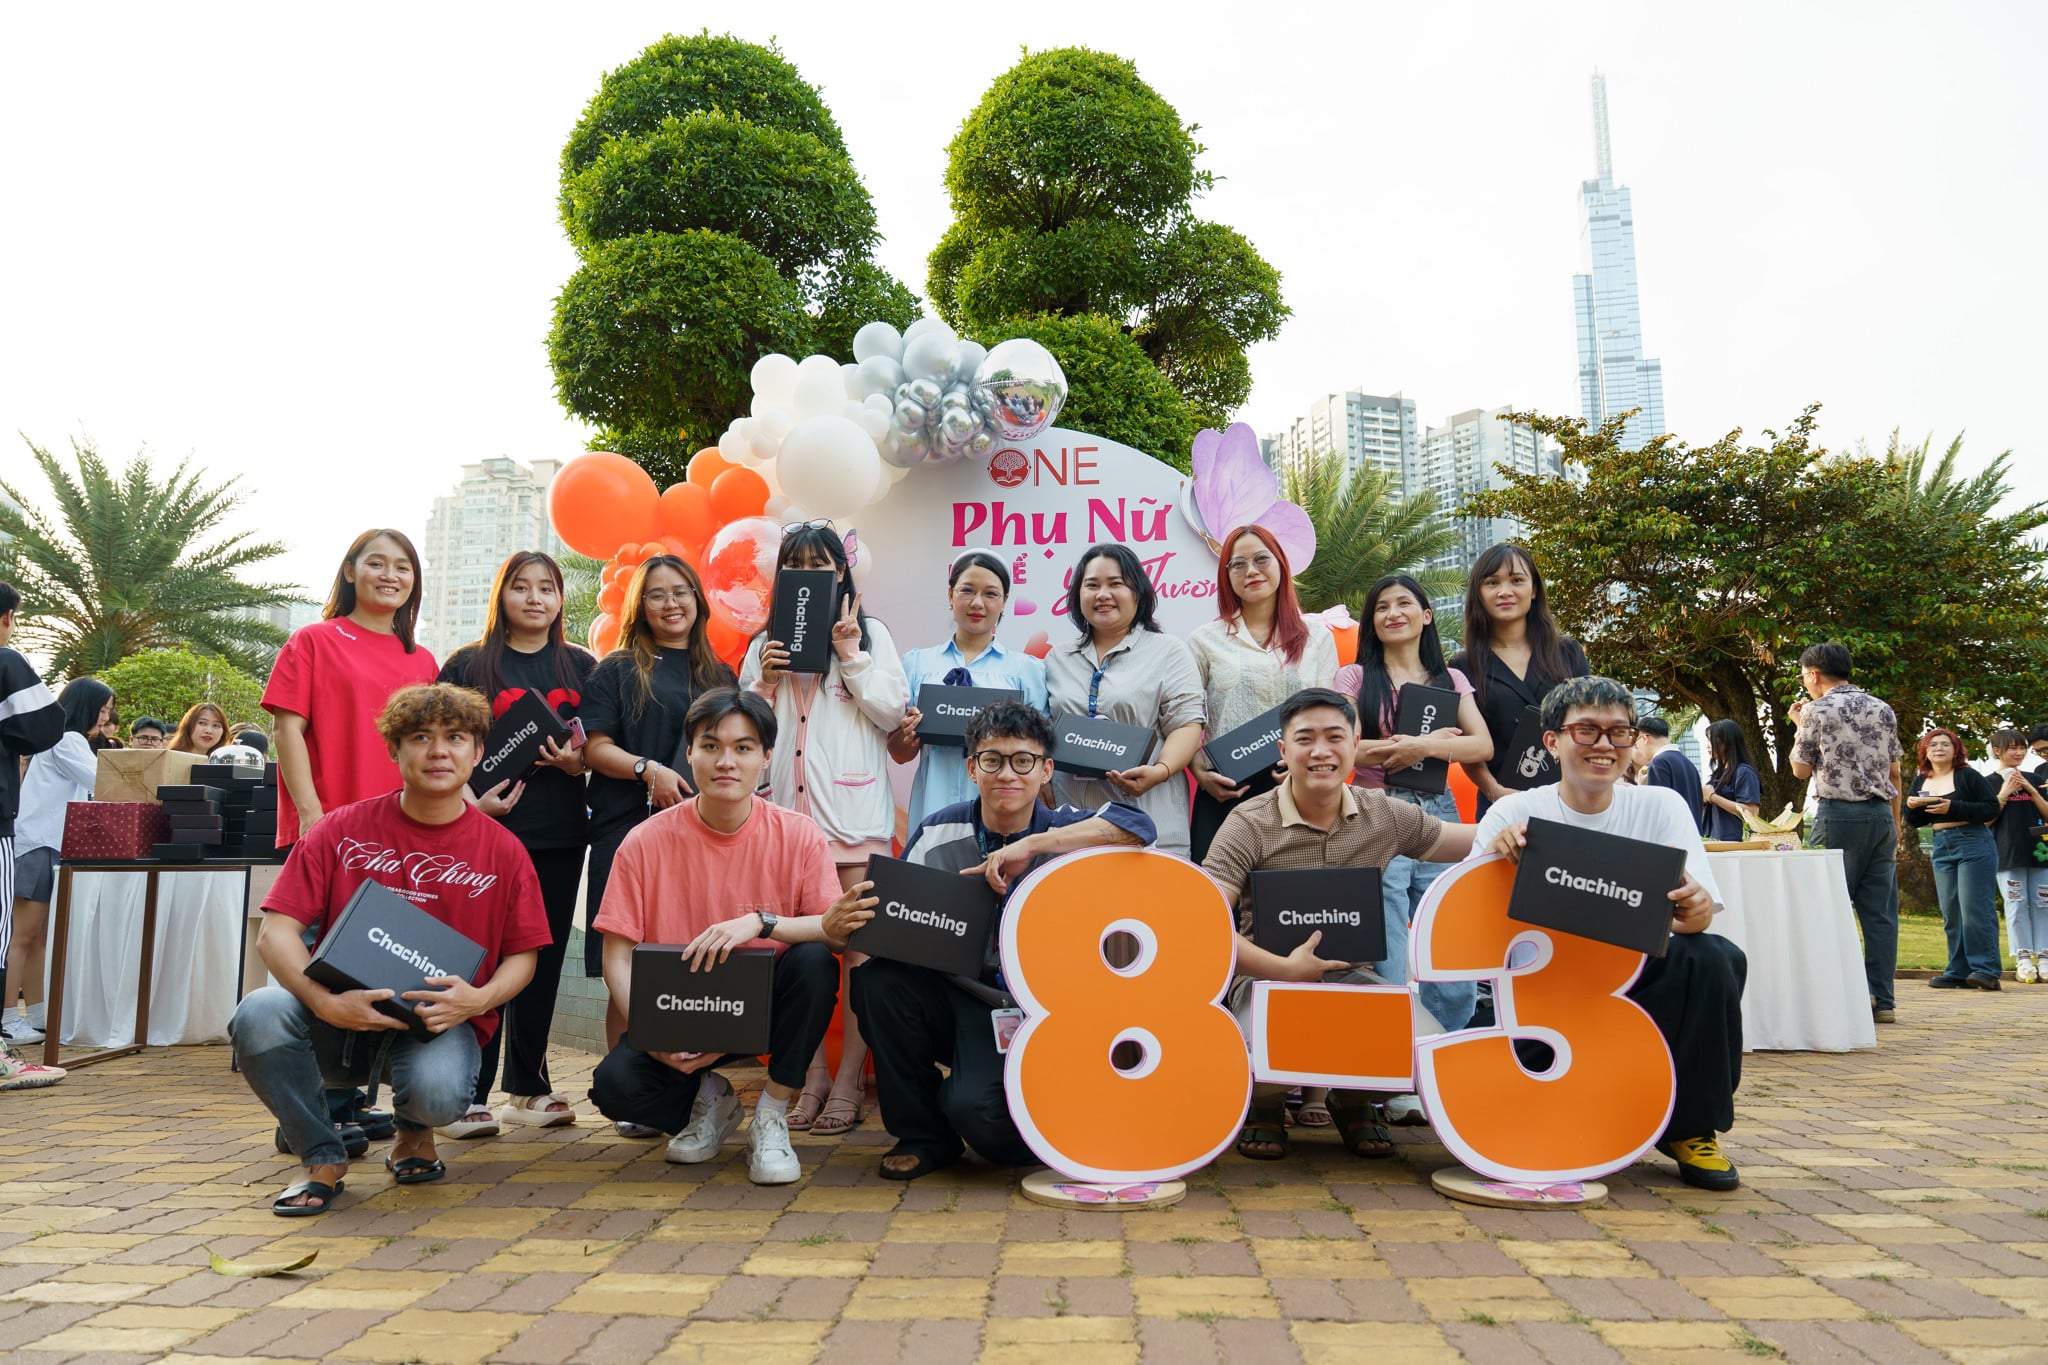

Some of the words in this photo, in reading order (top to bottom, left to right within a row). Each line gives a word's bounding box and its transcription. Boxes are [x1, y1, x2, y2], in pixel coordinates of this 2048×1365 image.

[952, 502, 1067, 559] Phụ
[1088, 497, 1173, 542] Nữ
[790, 586, 811, 653] Chaching
[935, 703, 984, 718] Chach
[482, 720, 539, 773] Chaching
[1064, 732, 1127, 757] Chaching
[1230, 728, 1283, 760] Chachin
[337, 836, 402, 876] Cha
[402, 851, 499, 899] Ching
[1545, 866, 1643, 908] Chaching
[885, 901, 968, 937] Chaching
[1278, 908, 1361, 927] Chaching
[656, 993, 745, 1017] Chaching
[999, 845, 1677, 1184] 8-3
